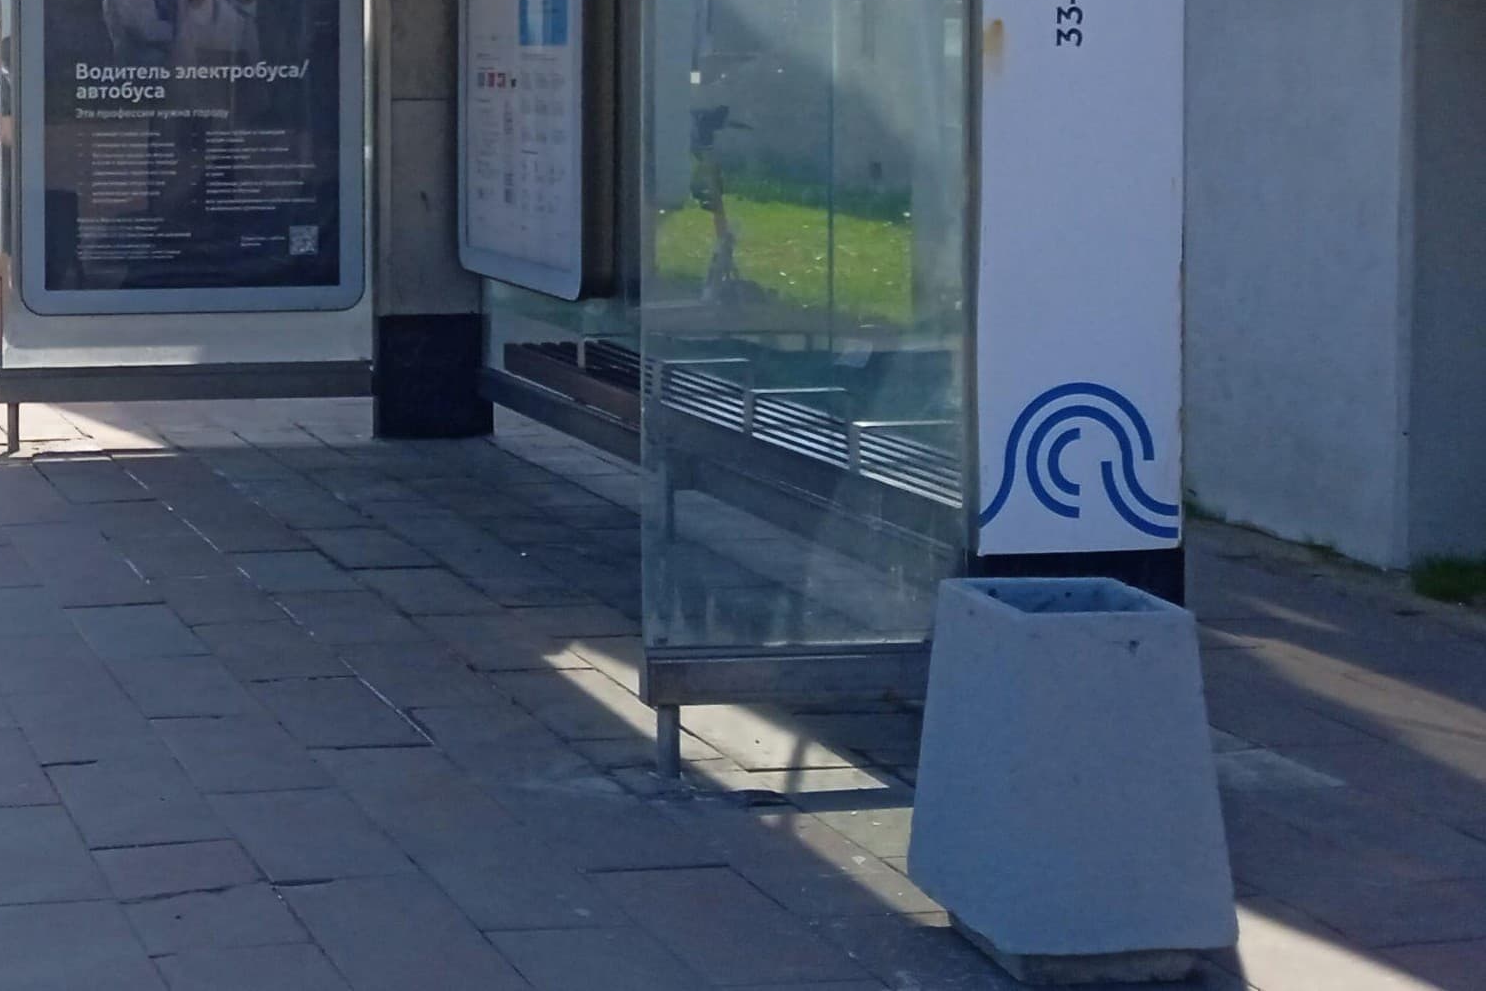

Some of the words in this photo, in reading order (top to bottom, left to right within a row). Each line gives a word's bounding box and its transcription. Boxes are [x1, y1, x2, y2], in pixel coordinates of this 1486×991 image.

[75, 62, 171, 82] Водитель
[174, 58, 311, 83] электробуса/
[75, 82, 166, 103] автобуса
